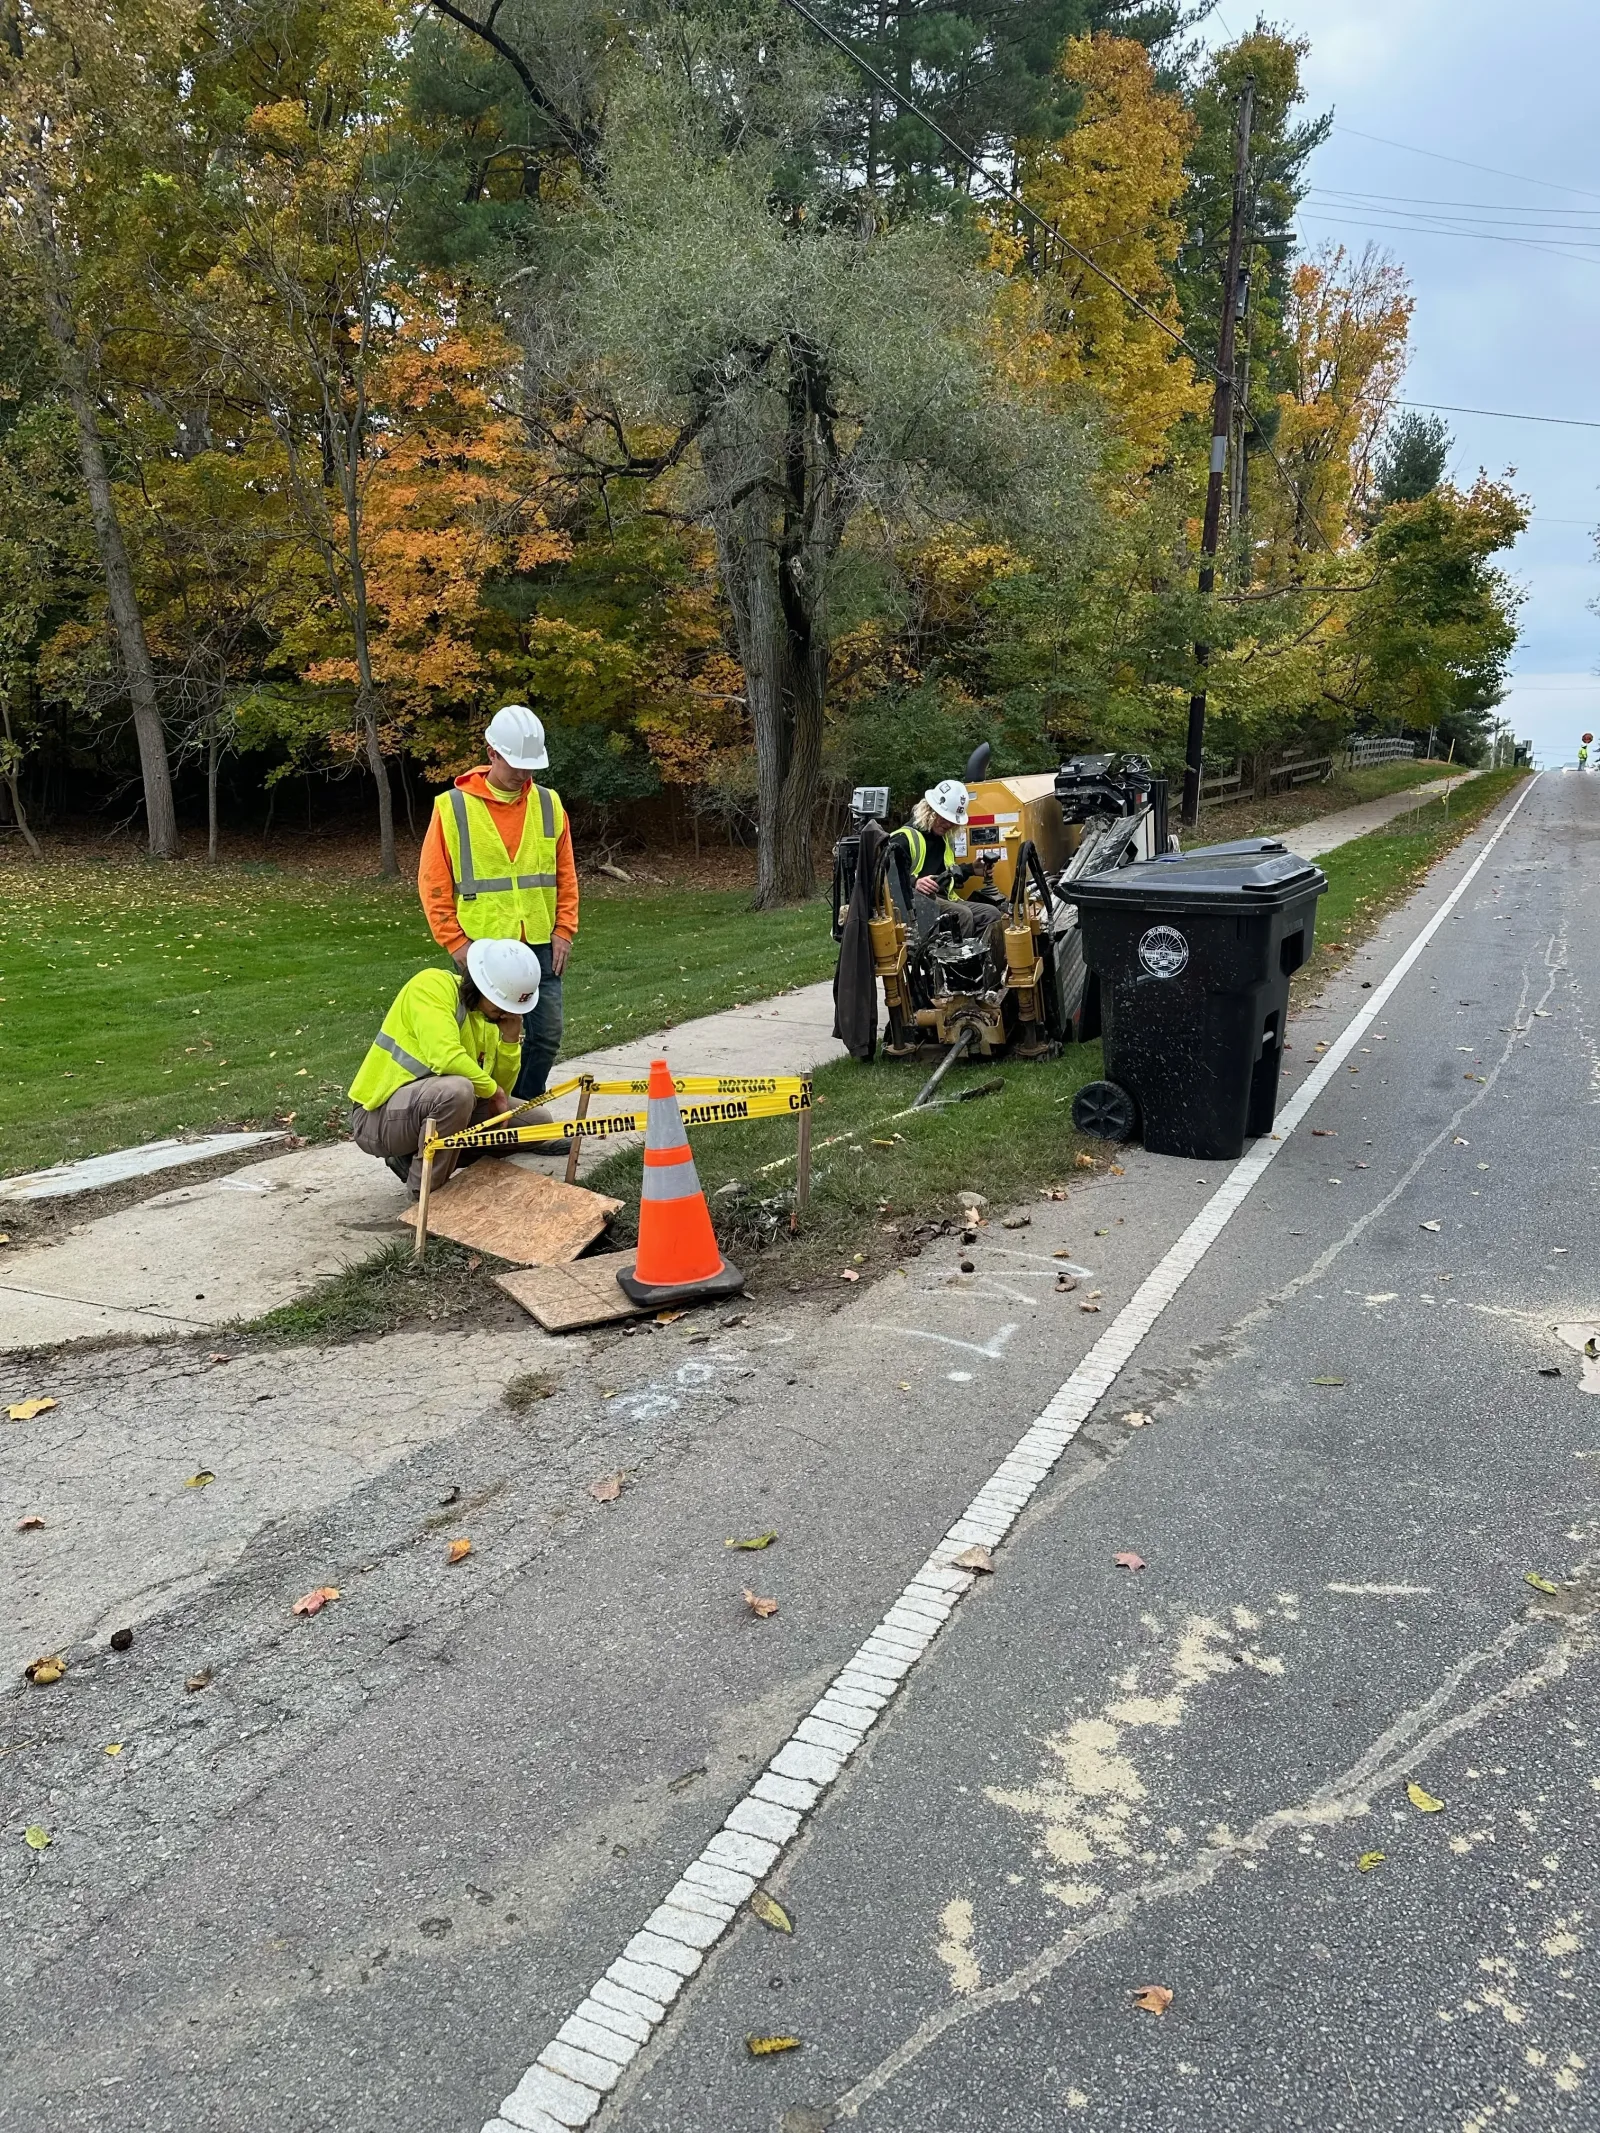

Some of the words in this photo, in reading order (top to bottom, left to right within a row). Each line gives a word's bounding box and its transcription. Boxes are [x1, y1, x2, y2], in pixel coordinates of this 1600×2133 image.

[443, 1130, 519, 1148] CAUTION
[563, 1116, 636, 1138] CAUTION
[680, 1101, 748, 1125] CAUTION
